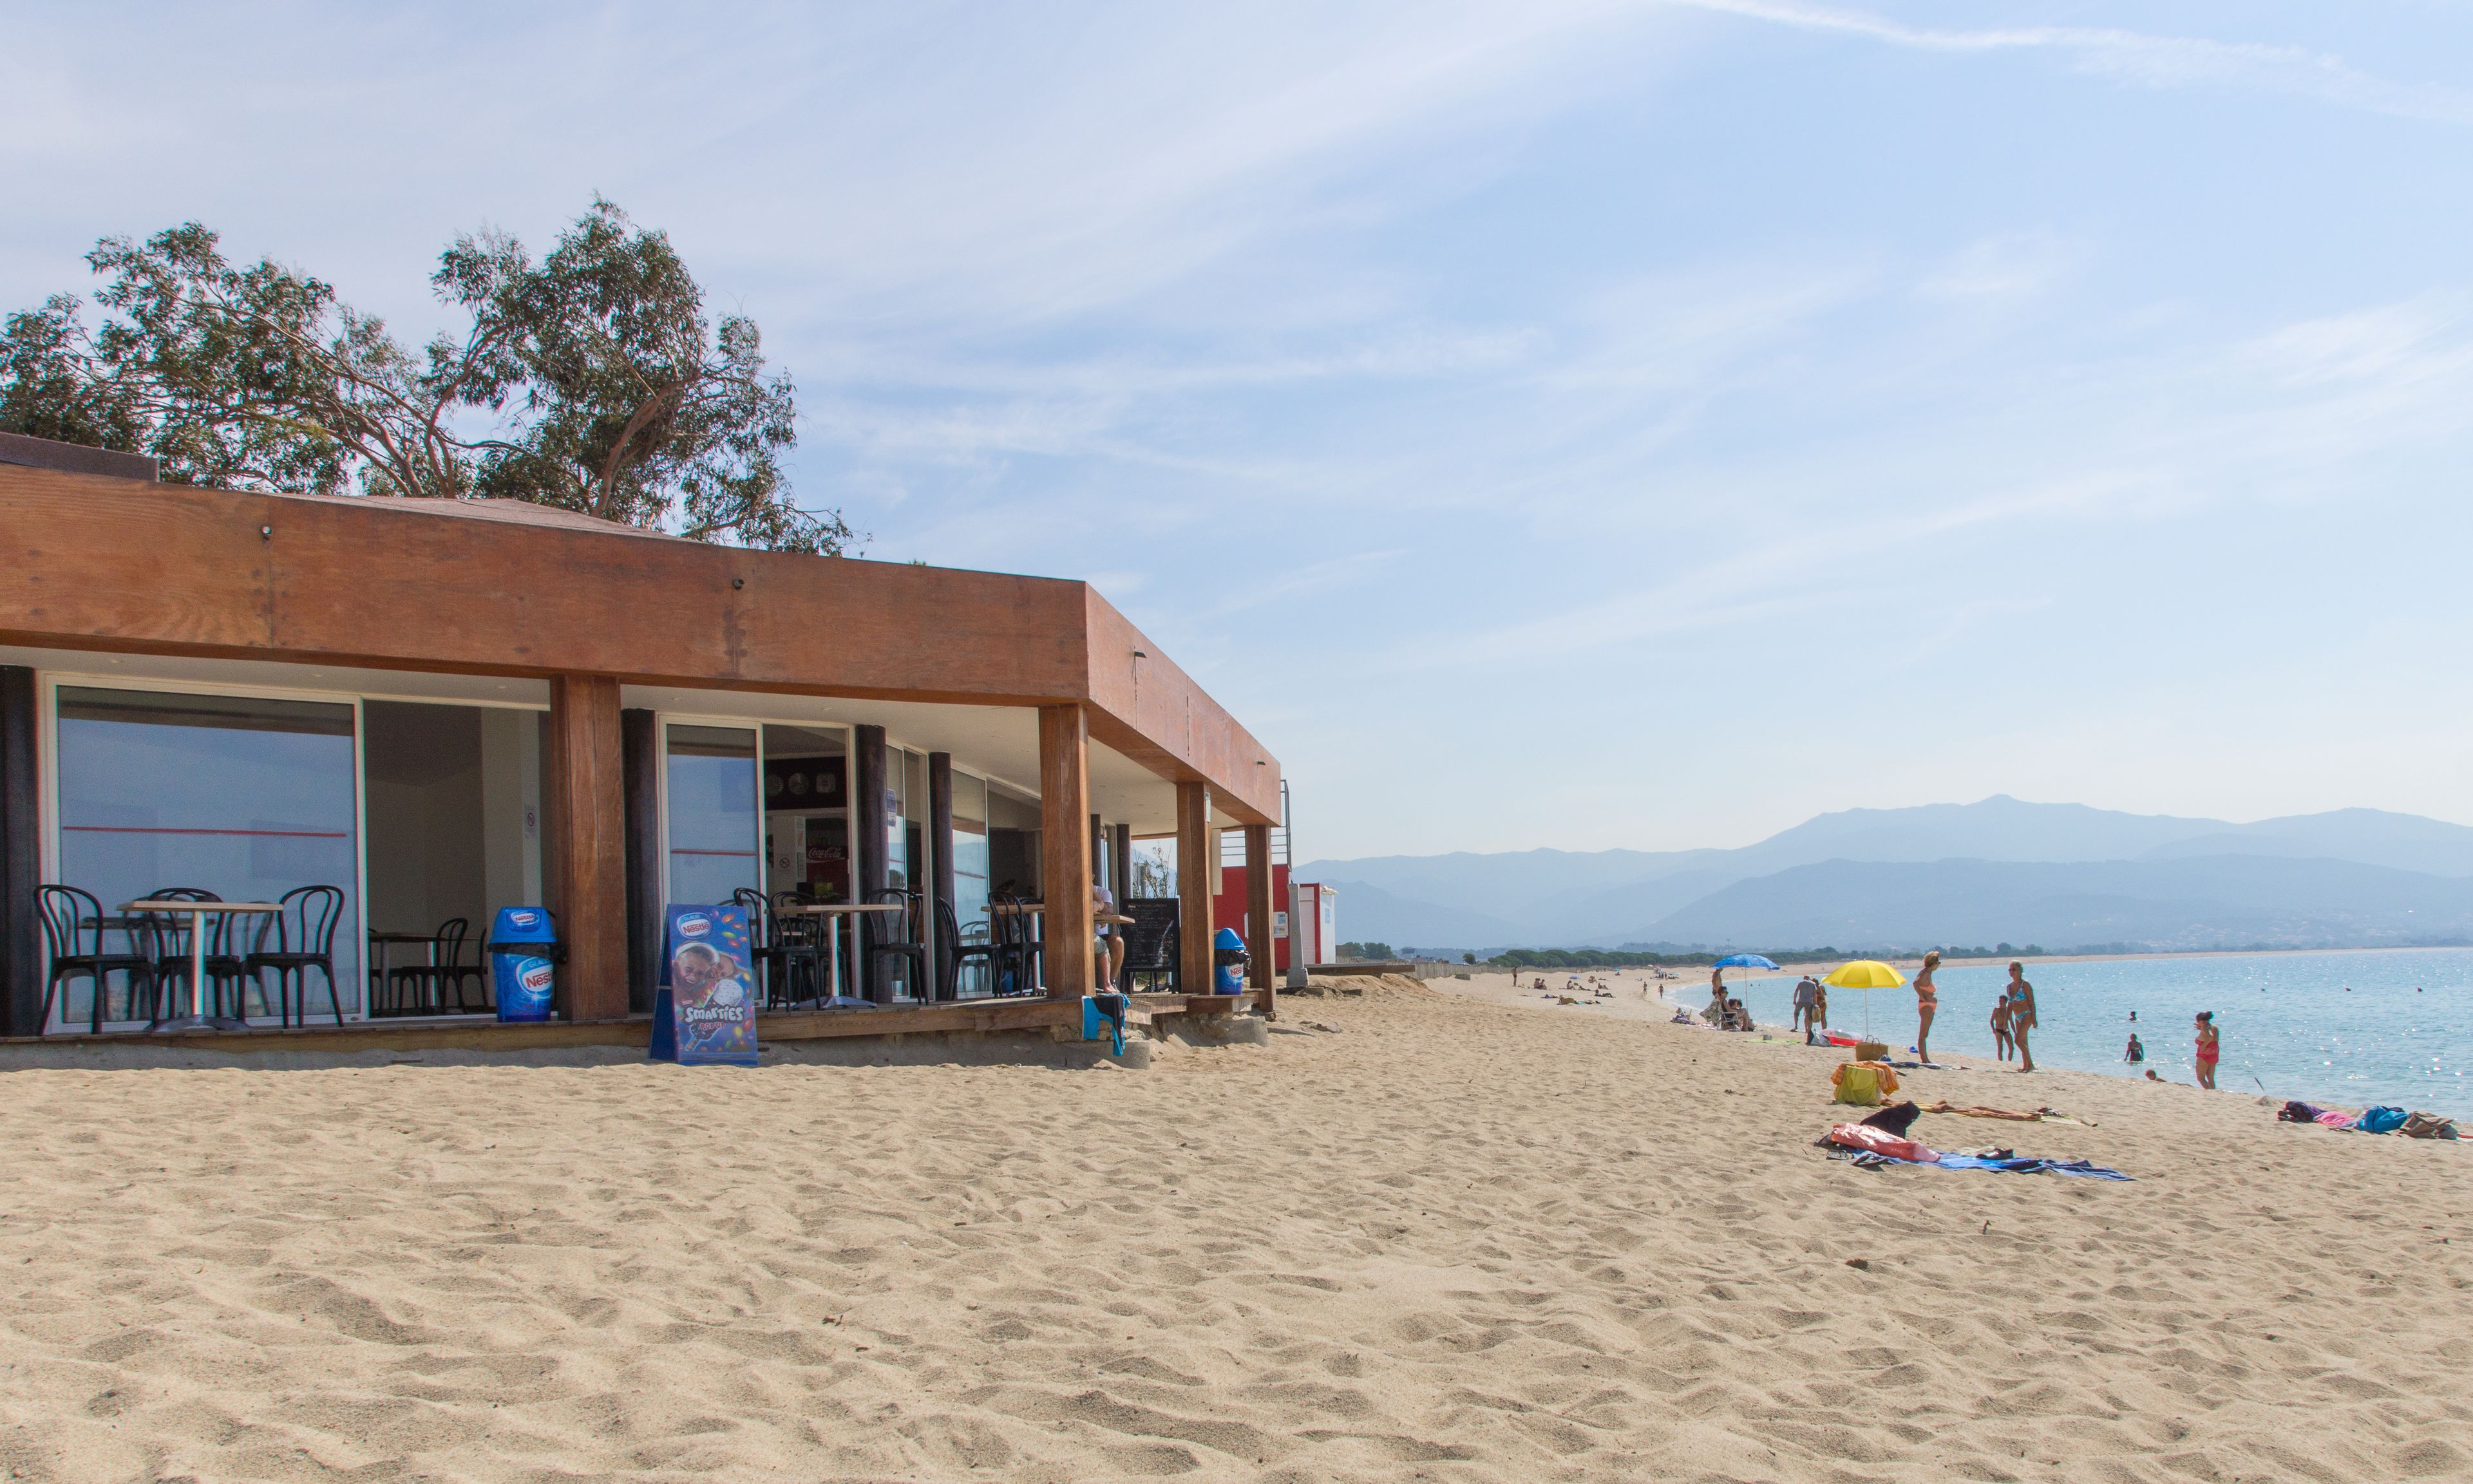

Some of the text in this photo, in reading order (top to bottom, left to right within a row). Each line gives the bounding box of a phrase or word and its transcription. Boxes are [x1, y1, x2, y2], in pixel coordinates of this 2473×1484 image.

[683, 922, 709, 934] Nestlé
[1230, 966, 1243, 975] Nes
[526, 971, 553, 988] Nest
